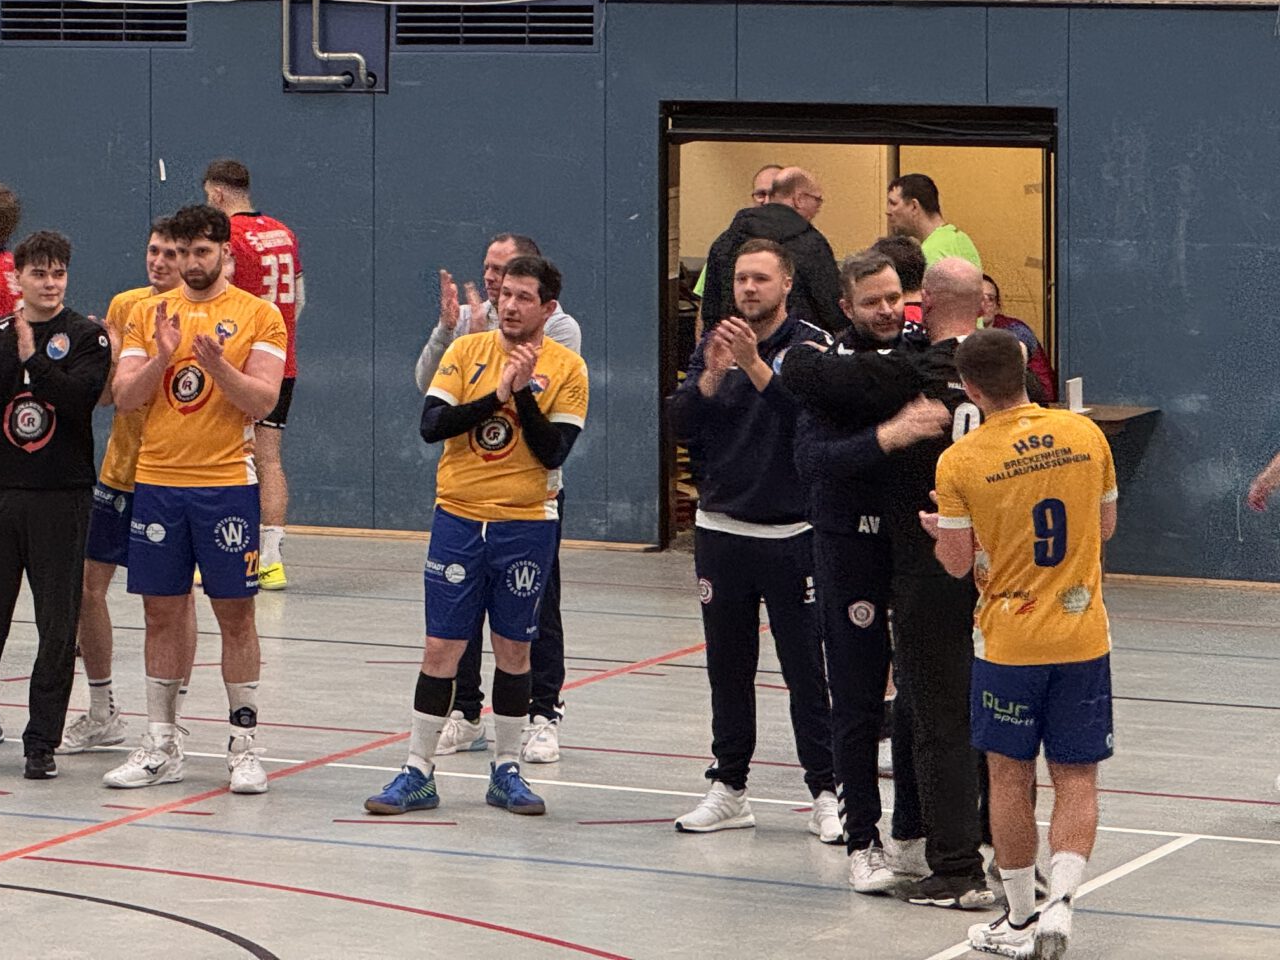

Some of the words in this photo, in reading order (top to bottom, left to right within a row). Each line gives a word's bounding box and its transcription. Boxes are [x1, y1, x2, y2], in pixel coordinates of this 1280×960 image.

[261, 252, 294, 303] 33
[1013, 434, 1054, 455] HSG
[858, 515, 880, 533] AV
[1032, 498, 1067, 567] 9
